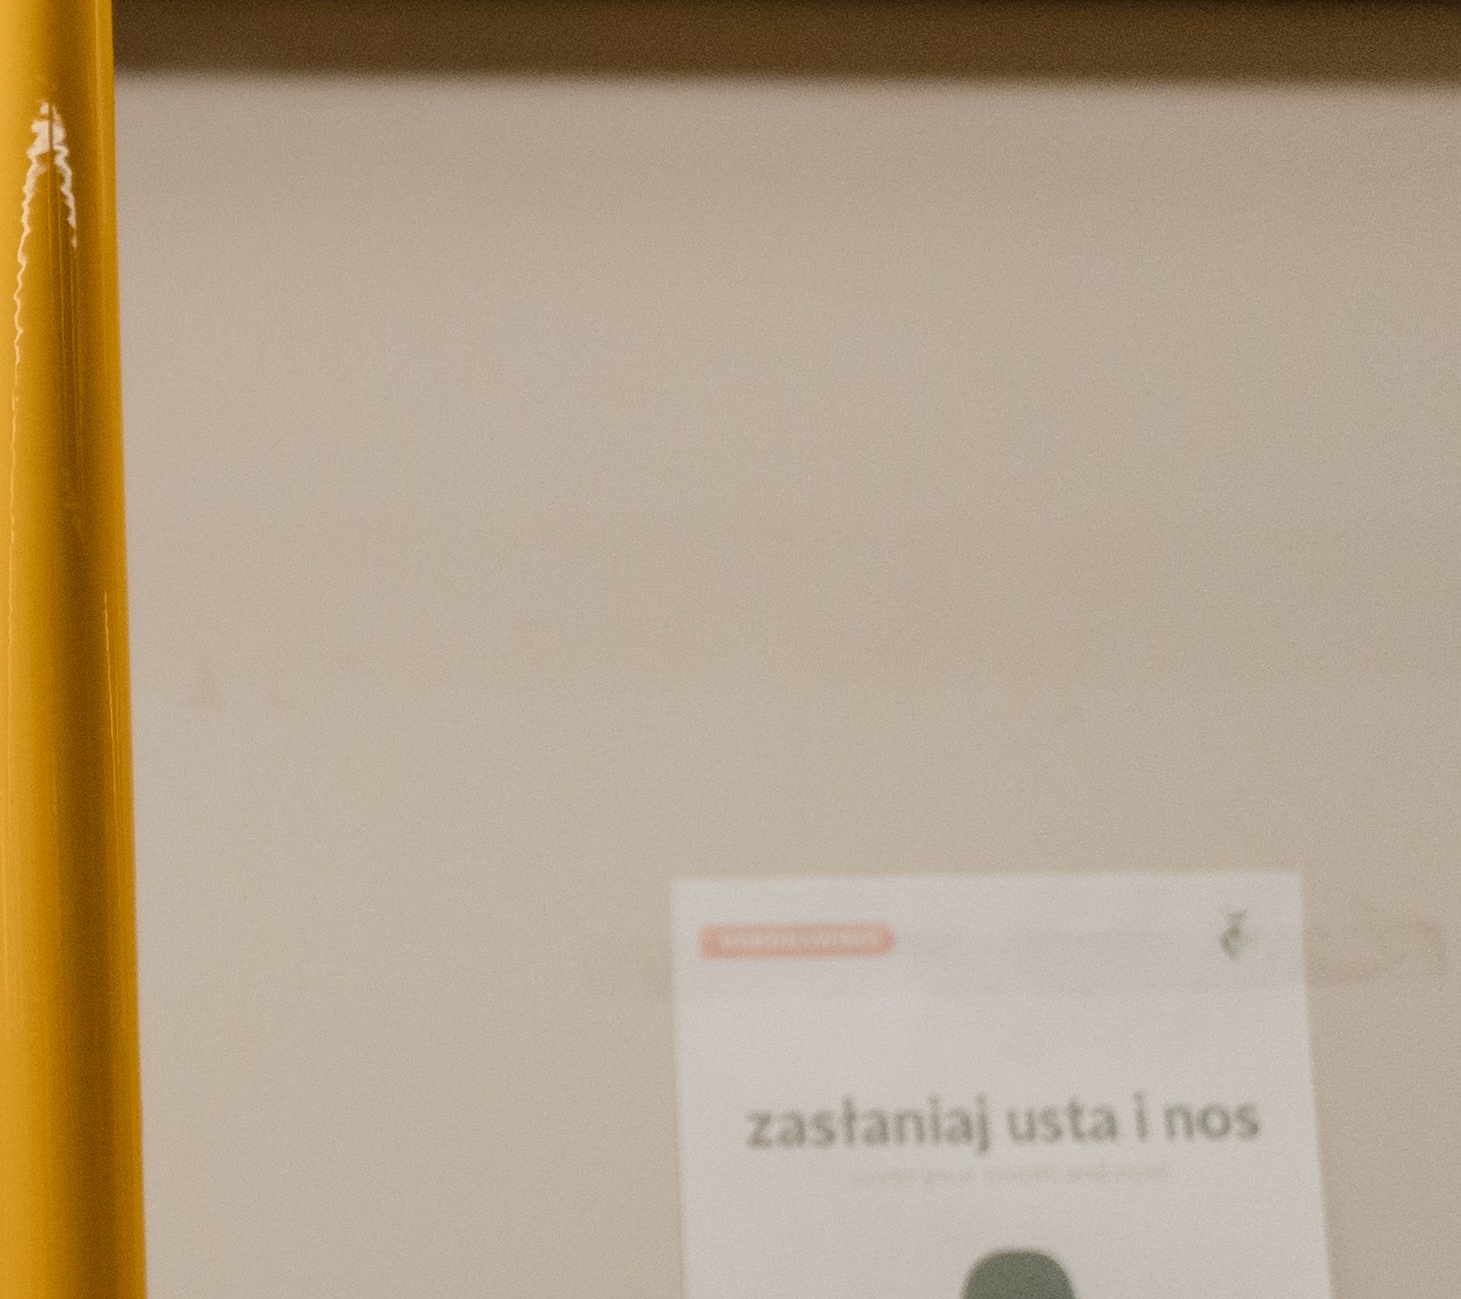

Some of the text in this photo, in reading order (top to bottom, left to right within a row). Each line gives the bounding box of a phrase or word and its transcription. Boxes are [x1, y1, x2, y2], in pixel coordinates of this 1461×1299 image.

[745, 1088, 1262, 1156] zasłaniaj usta i nos
